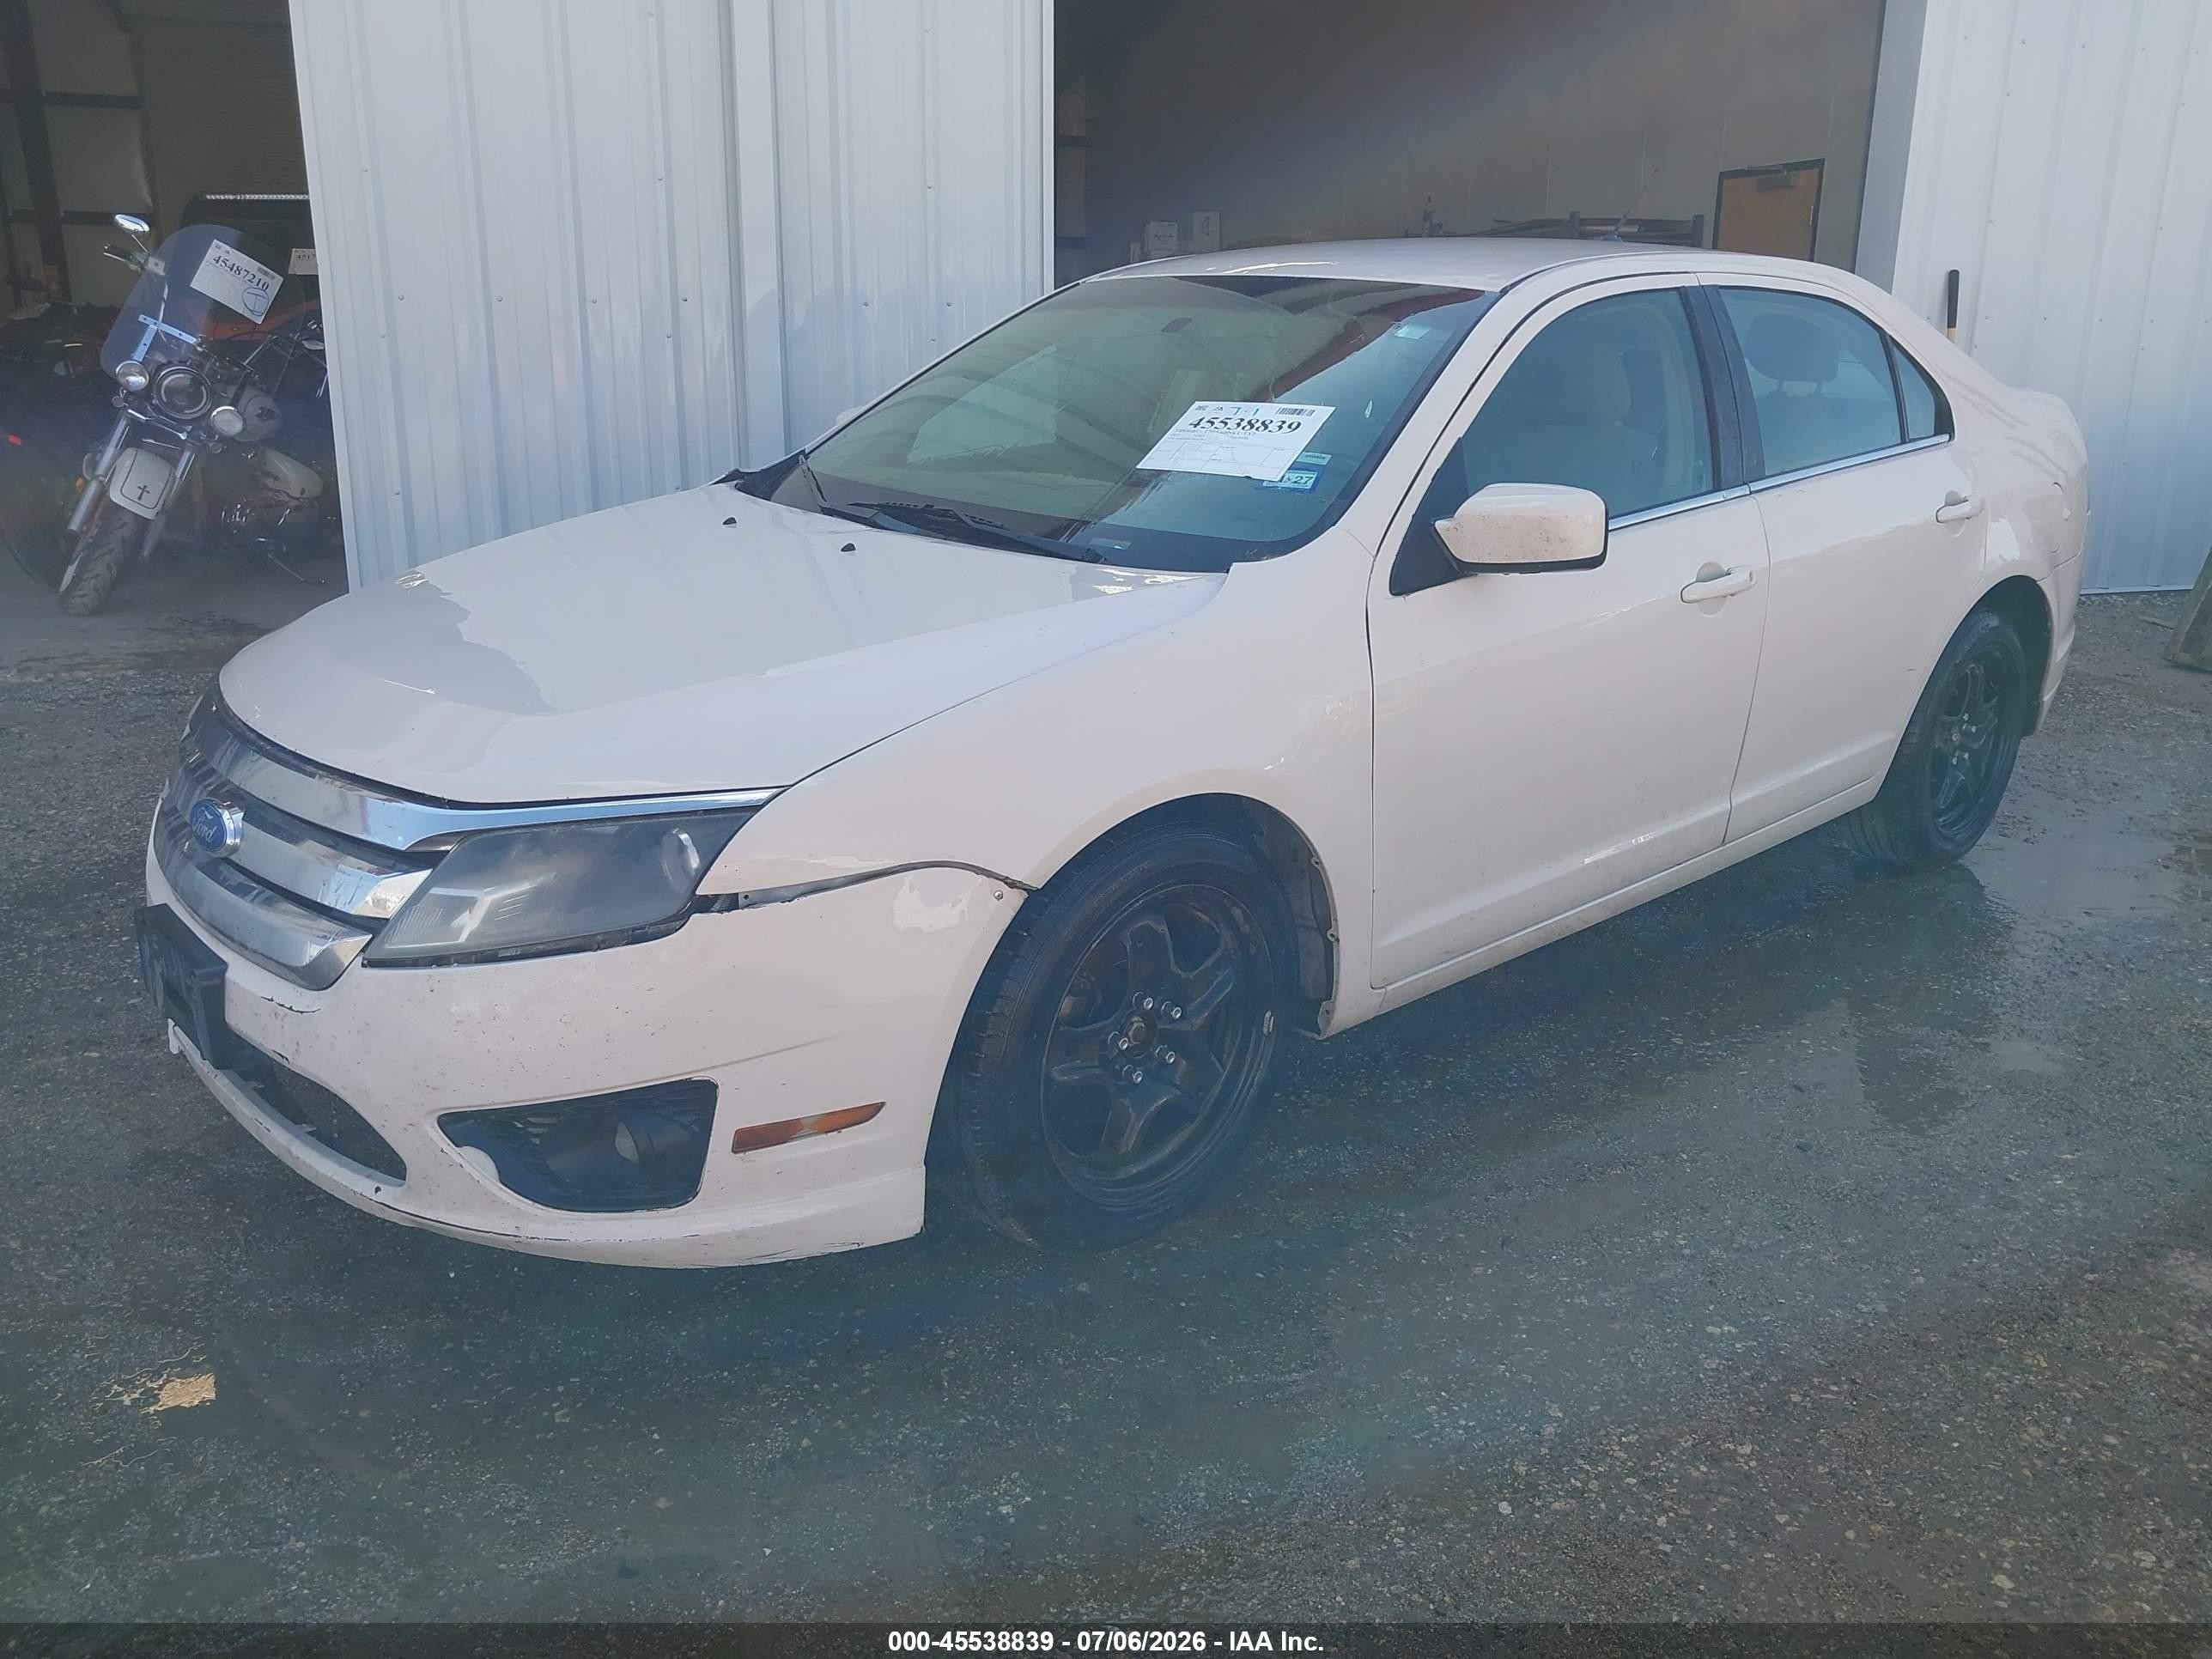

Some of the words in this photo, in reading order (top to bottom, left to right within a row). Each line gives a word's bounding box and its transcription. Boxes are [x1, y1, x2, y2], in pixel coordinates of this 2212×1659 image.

[213, 255, 270, 291] 45487210
[1188, 416, 1302, 434] 45538839
[1292, 475, 1314, 484] 27
[191, 806, 218, 842] Ford
